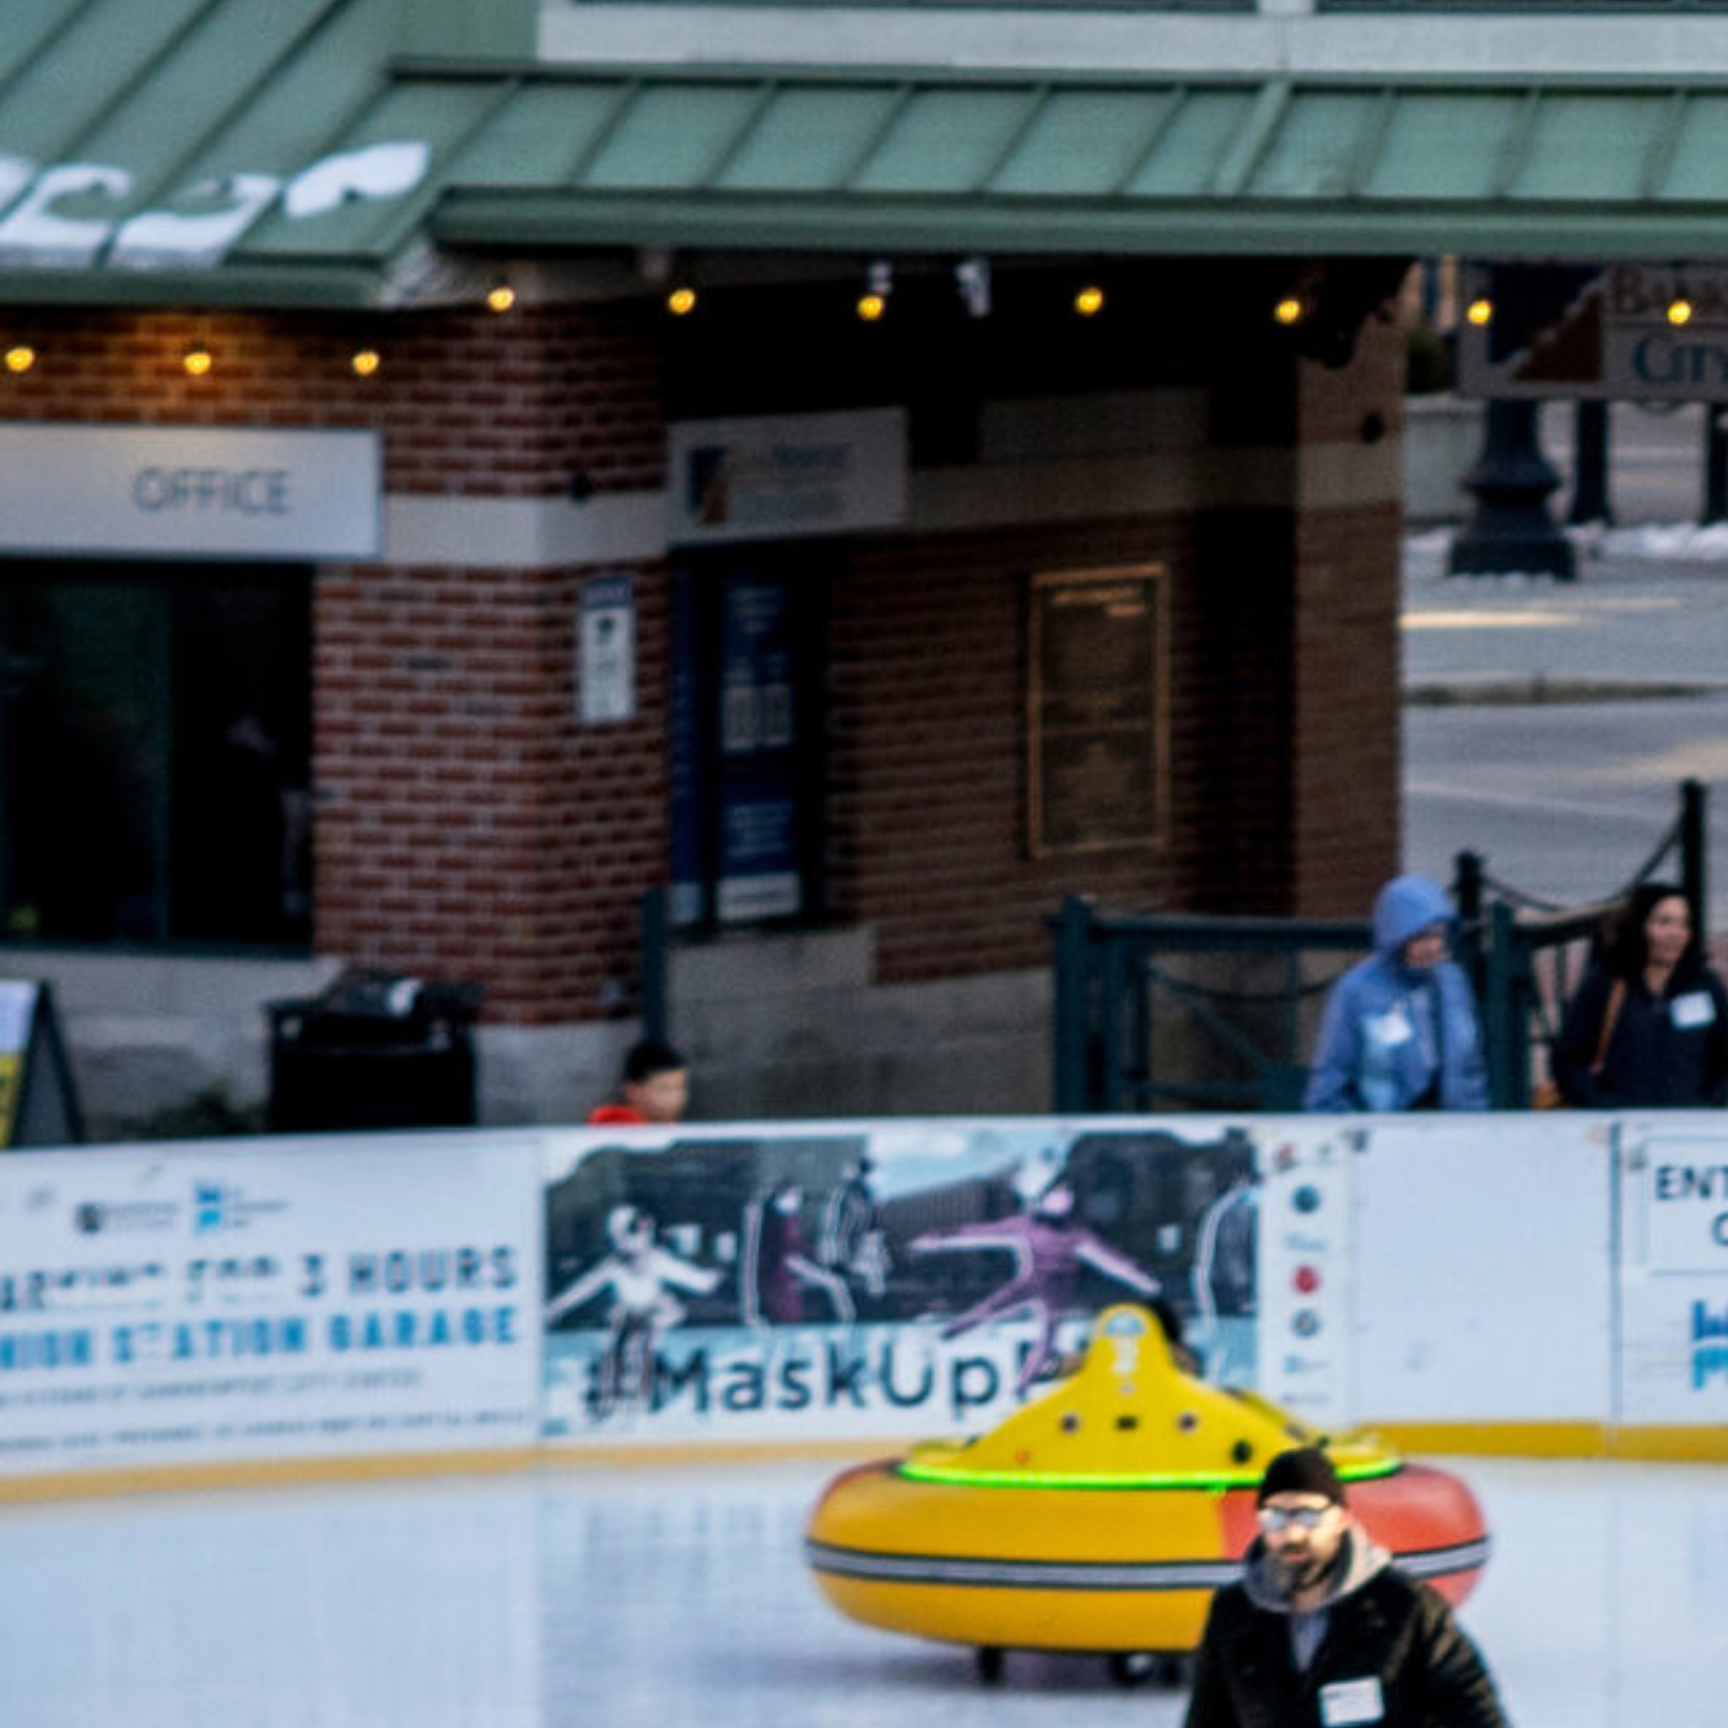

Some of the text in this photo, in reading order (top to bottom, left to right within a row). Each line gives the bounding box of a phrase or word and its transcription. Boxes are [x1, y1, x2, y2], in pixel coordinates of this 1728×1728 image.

[134, 468, 296, 514] OFFICE
[300, 1251, 327, 1298] 3
[348, 1246, 518, 1296] HOURS
[328, 1305, 518, 1354] GARAGE
